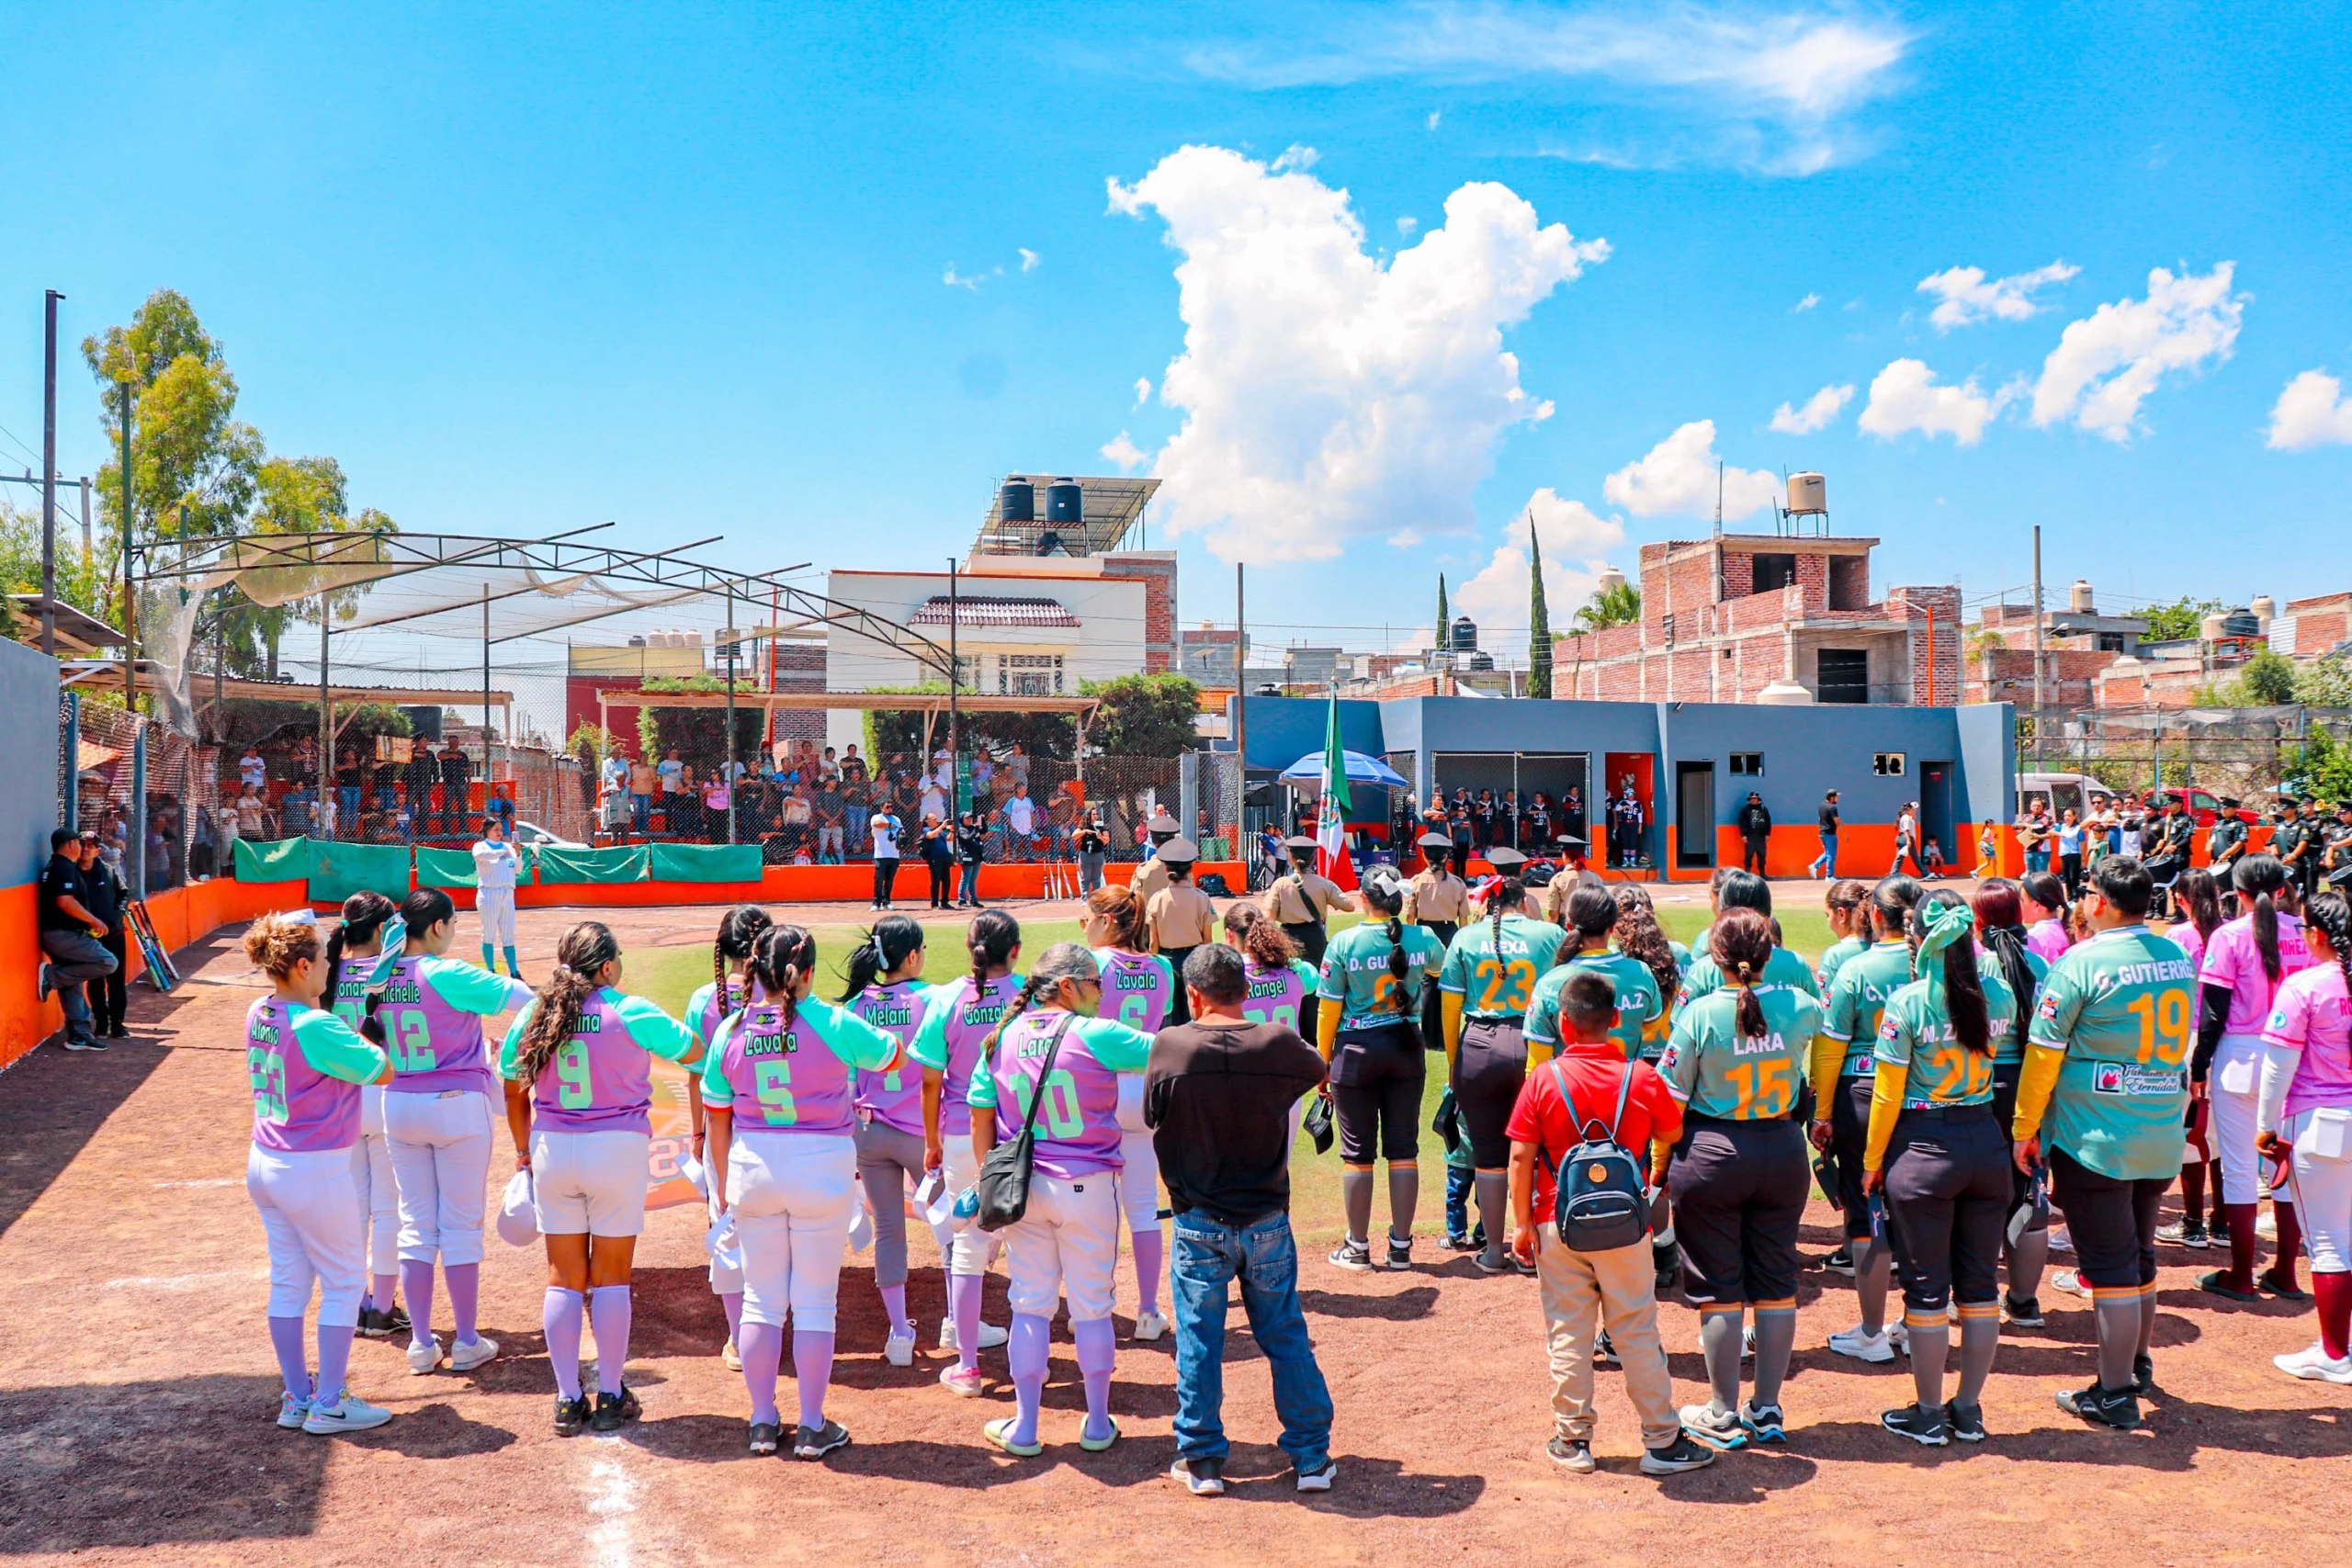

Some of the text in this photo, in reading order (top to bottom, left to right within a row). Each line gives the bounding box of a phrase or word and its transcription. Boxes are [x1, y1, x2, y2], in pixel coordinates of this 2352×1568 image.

[1479, 940, 1530, 954] ALEXA
[1349, 953, 1425, 972] D. GUAN
[2118, 958, 2195, 986] GUTIERRE
[1115, 968, 1157, 990] Zavala
[1247, 974, 1286, 999] Rangel
[1476, 958, 1537, 1011] 23
[865, 1001, 911, 1027] Melani
[963, 998, 1011, 1027] Gonzal
[2128, 987, 2191, 1066] 19
[251, 1014, 279, 1046] Alonso
[379, 1010, 437, 1073] 12
[1733, 1032, 1785, 1055] LARA
[1018, 1032, 1055, 1058] Lara
[556, 1039, 594, 1110] 9
[1724, 1057, 1792, 1121] 15
[754, 1059, 798, 1126] 5
[1008, 1068, 1085, 1141] 10
